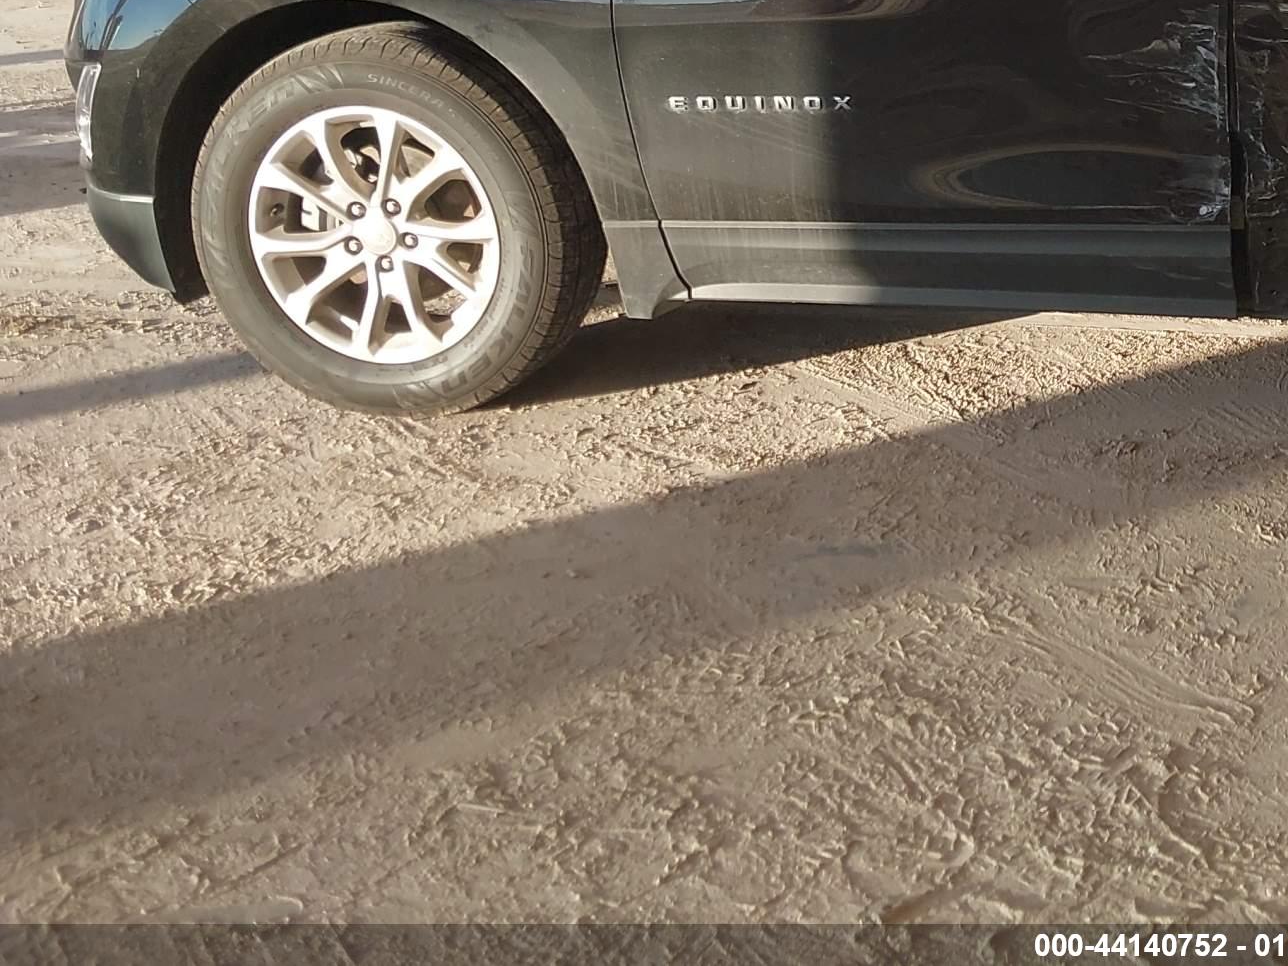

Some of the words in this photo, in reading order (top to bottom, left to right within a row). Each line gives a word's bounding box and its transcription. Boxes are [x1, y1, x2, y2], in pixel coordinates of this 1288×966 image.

[366, 73, 445, 109] SINCERA
[667, 95, 853, 112] EQUINOX
[440, 241, 537, 394] FALKEN
